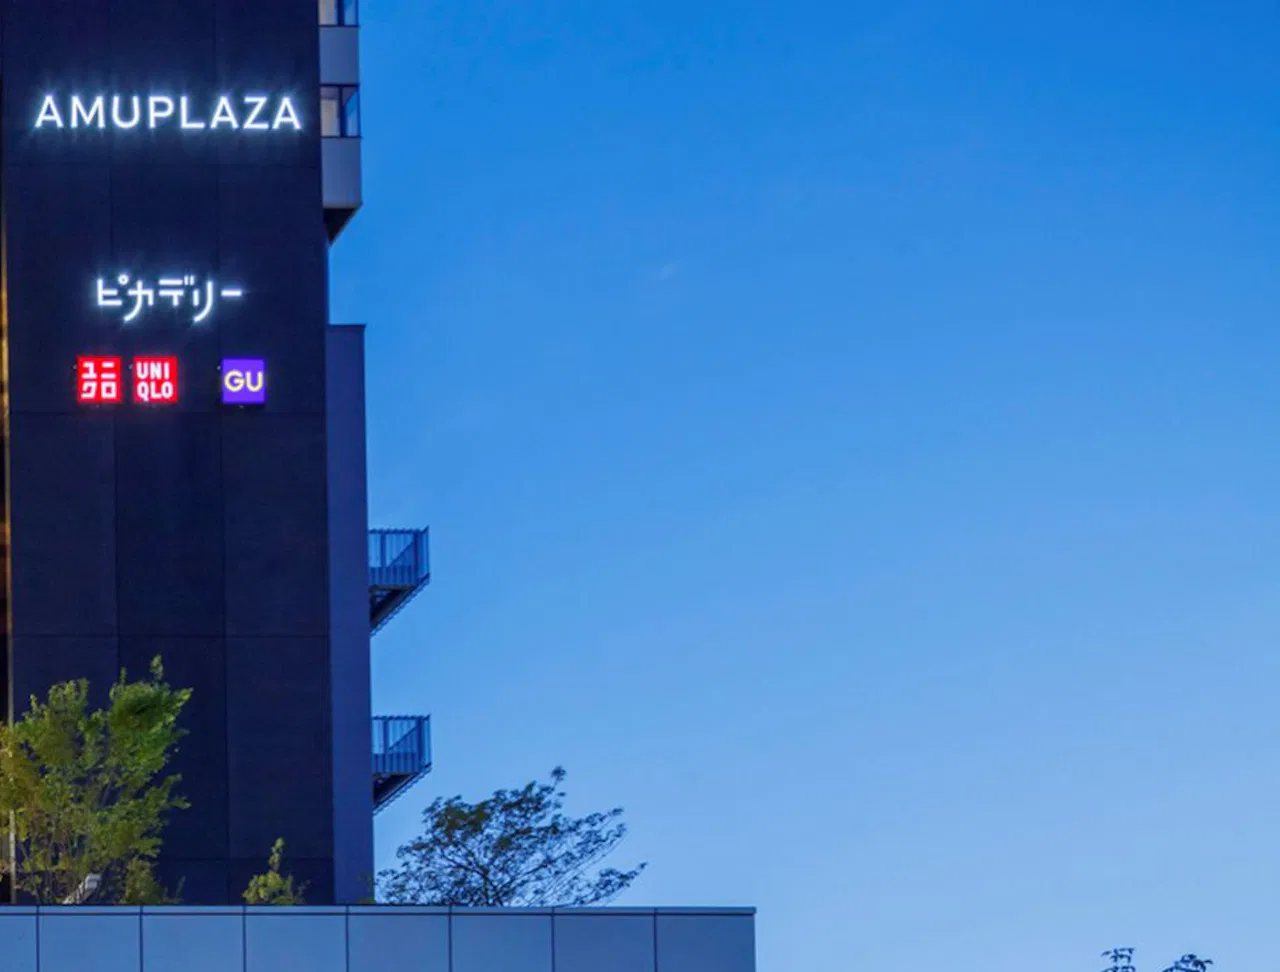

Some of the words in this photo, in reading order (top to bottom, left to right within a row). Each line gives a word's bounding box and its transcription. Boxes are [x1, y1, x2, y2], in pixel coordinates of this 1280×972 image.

[34, 95, 302, 129] AMUPLAZA
[96, 275, 242, 322] ピカデリー
[136, 361, 171, 380] UNI
[224, 370, 264, 392] GU
[137, 382, 174, 401] QLO
